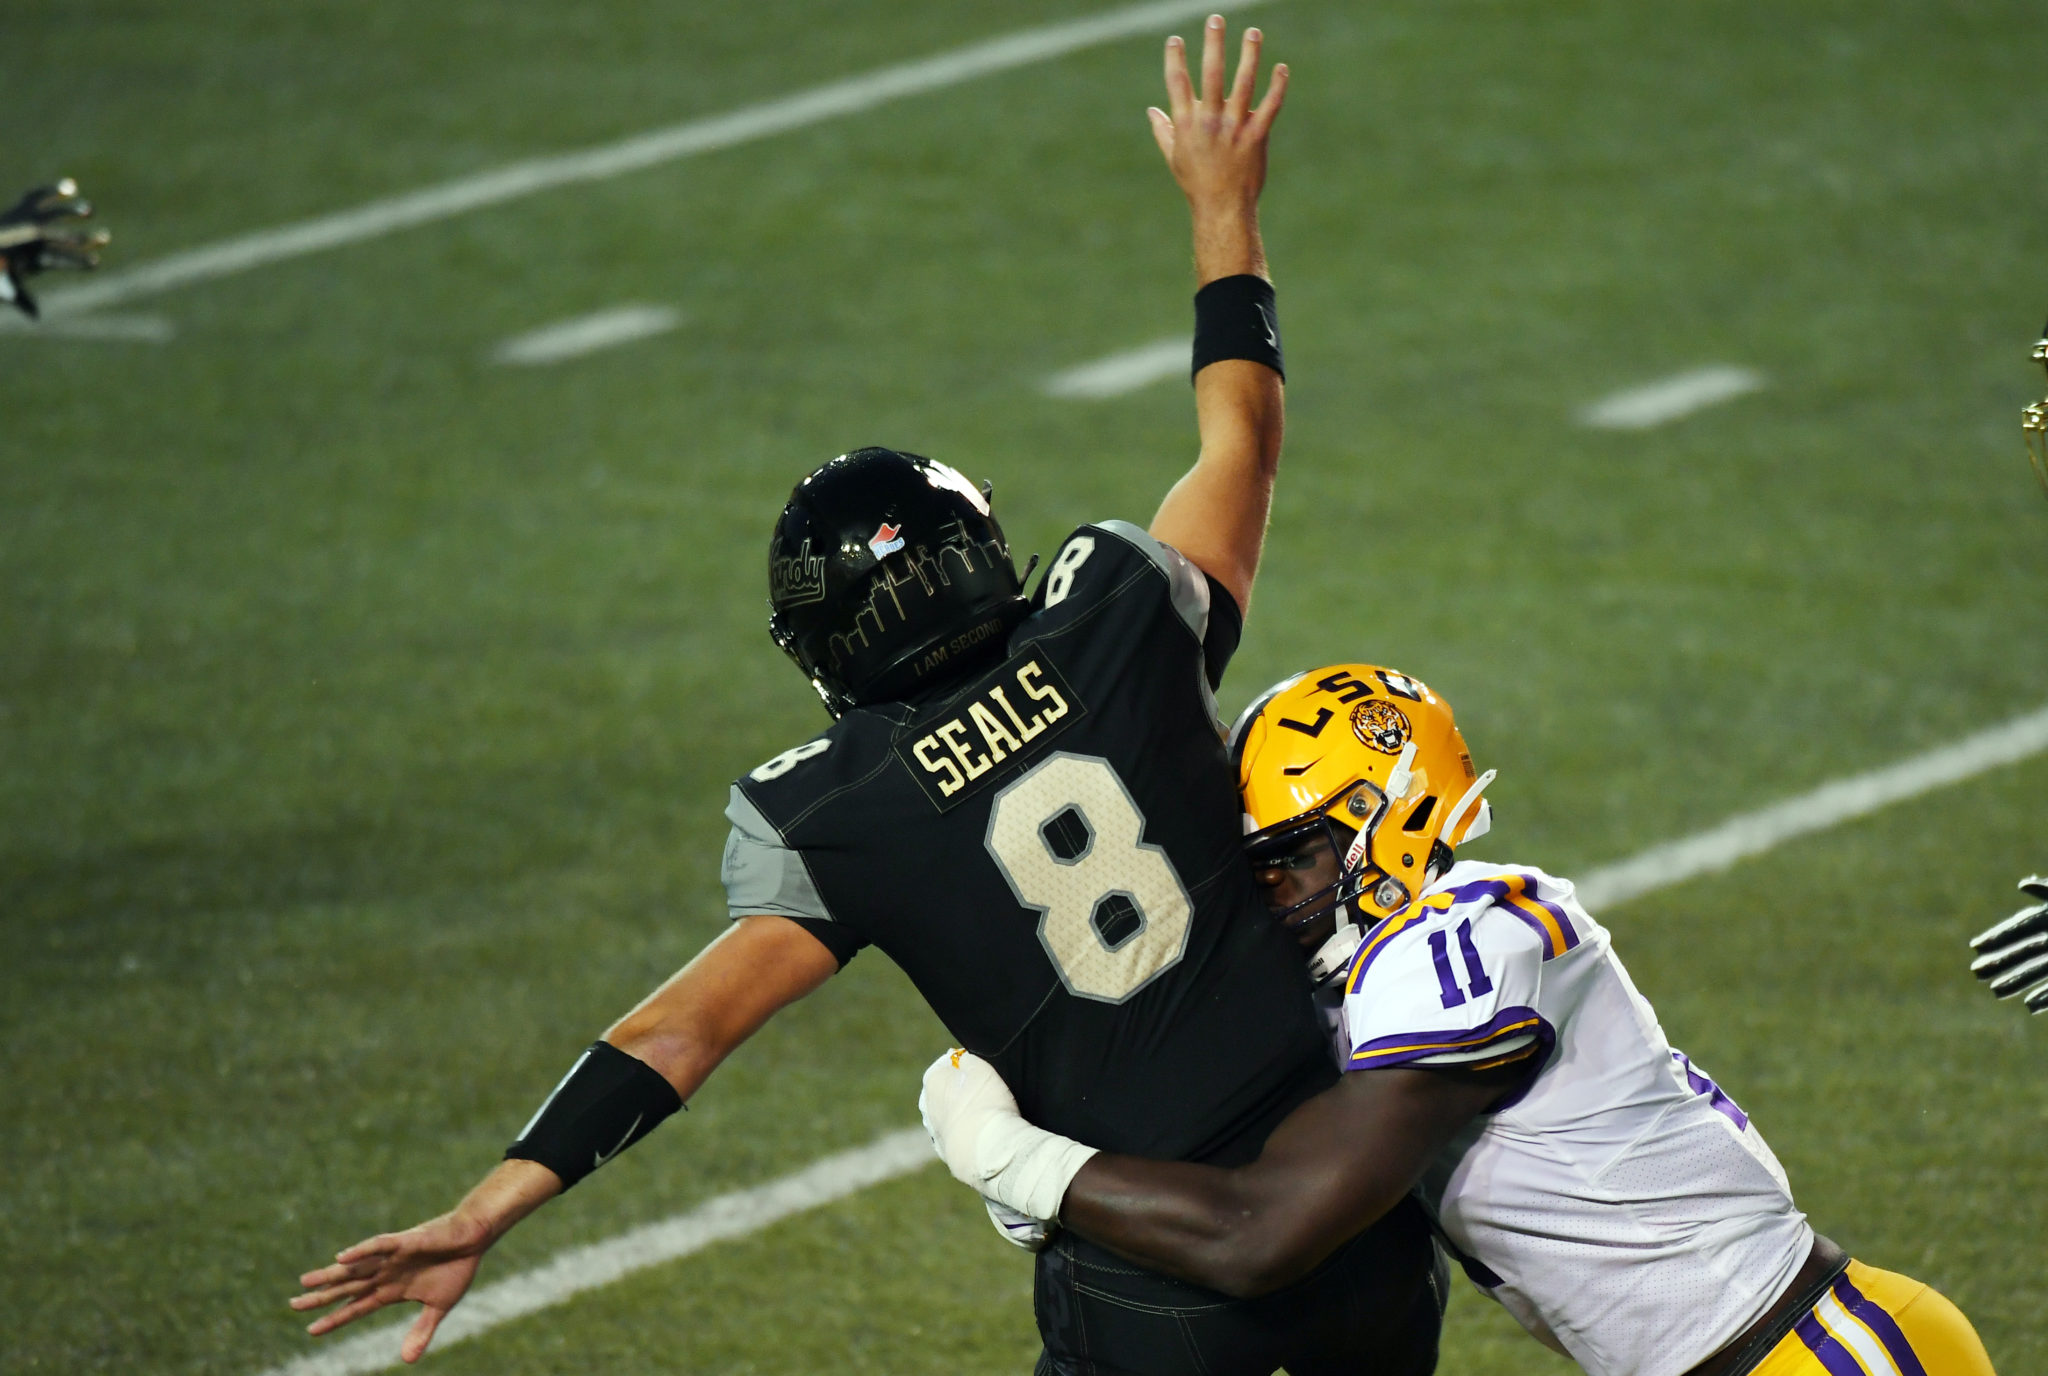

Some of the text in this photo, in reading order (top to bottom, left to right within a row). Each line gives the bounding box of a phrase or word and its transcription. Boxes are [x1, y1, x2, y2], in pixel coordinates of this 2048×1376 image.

[1045, 536, 1095, 609] 8
[924, 646, 949, 672] AM
[912, 660, 1069, 798] SEALS
[1277, 670, 1422, 739] LSU
[750, 738, 832, 783] 8
[984, 750, 1195, 1005] 8
[1427, 917, 1493, 1009] 11
